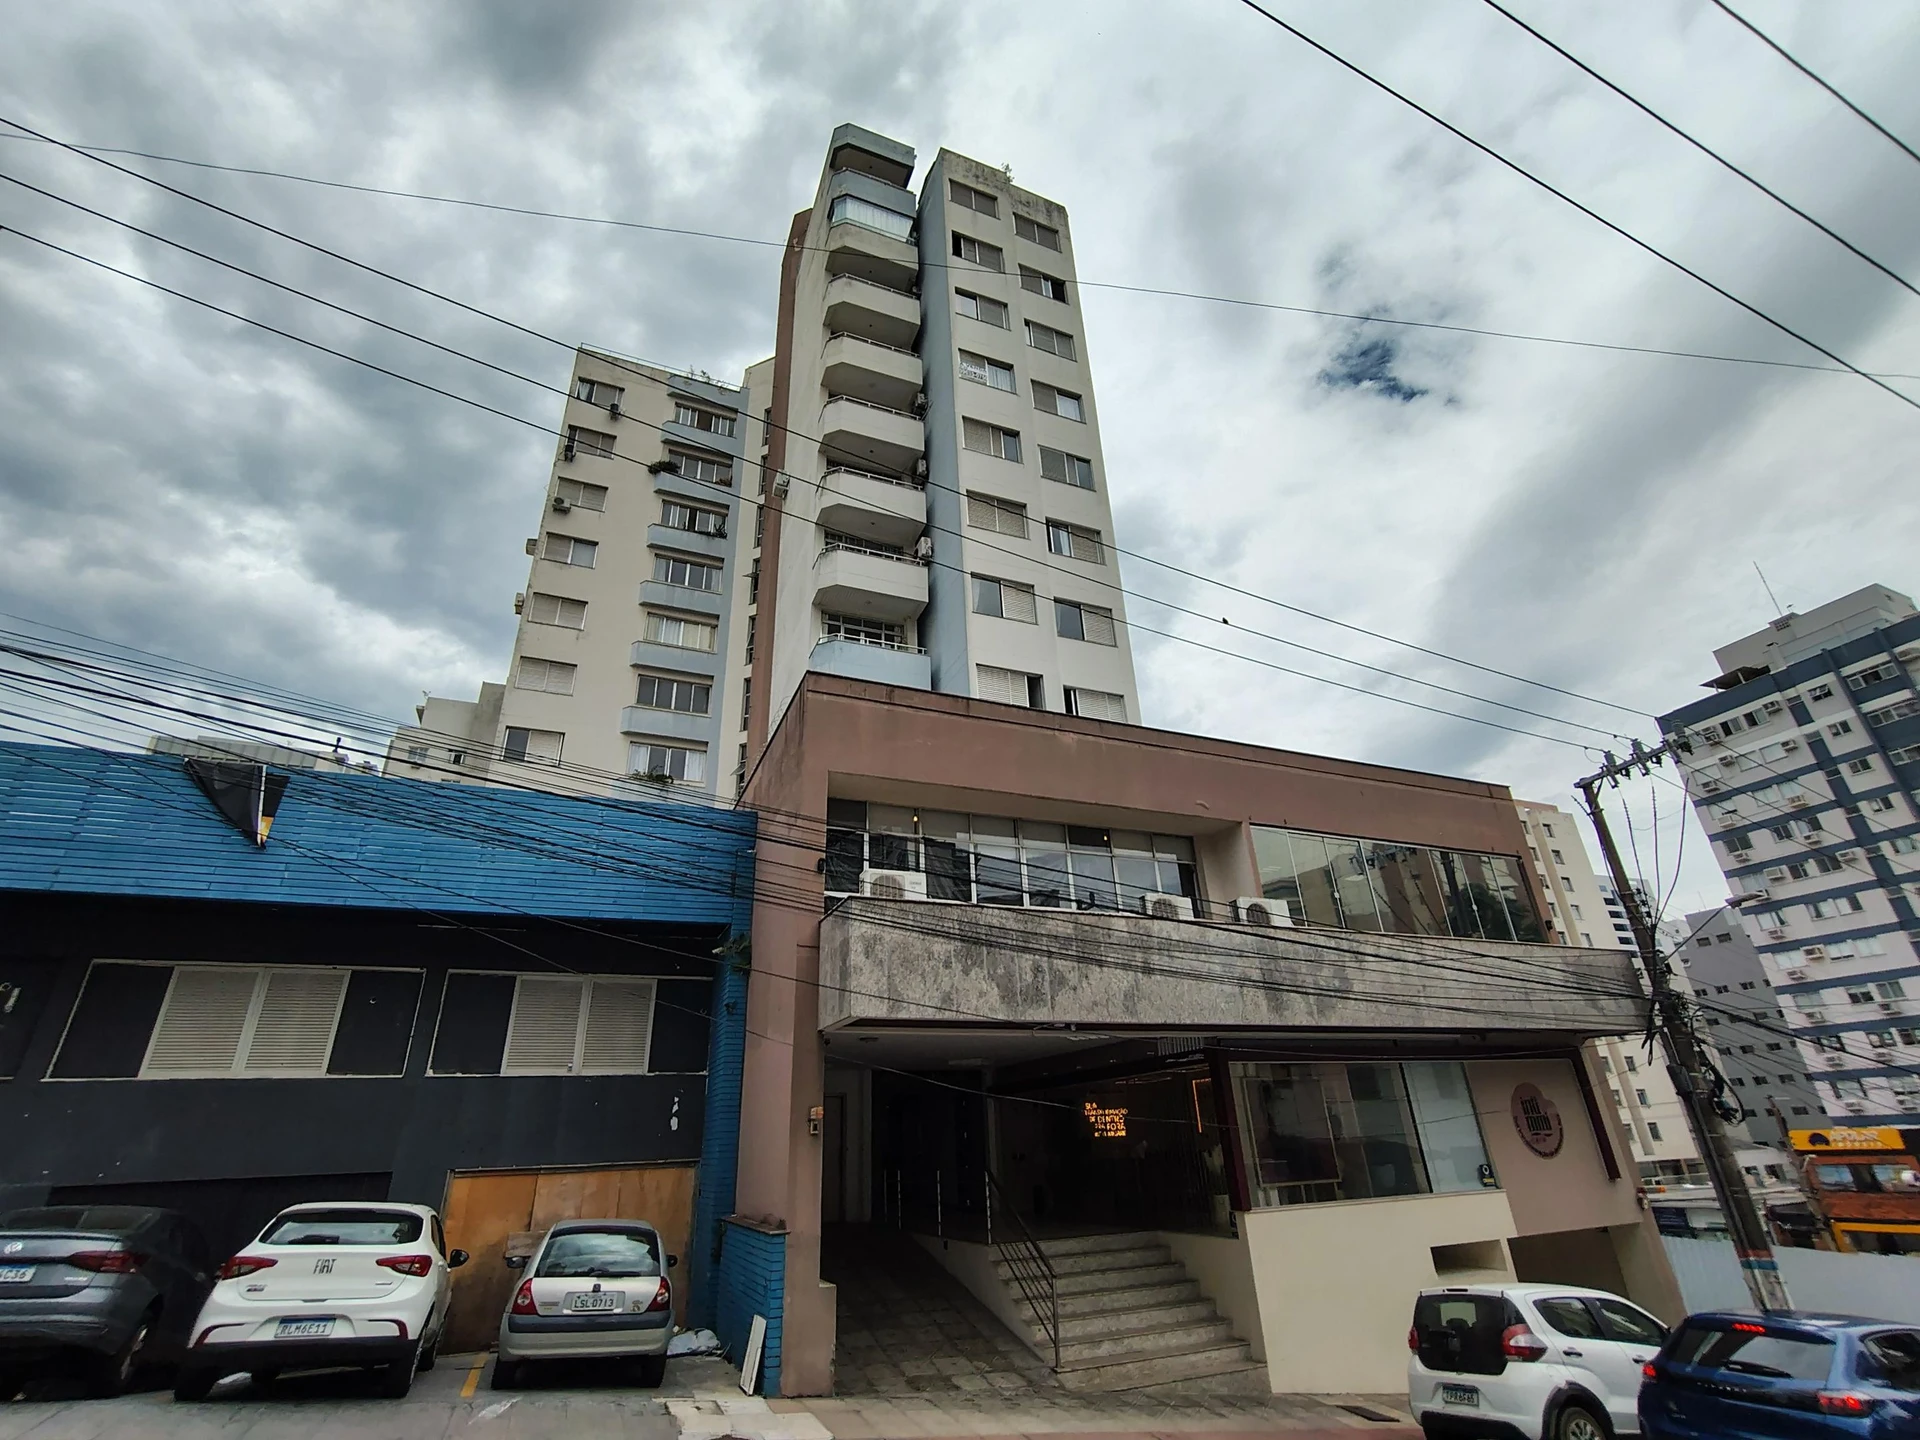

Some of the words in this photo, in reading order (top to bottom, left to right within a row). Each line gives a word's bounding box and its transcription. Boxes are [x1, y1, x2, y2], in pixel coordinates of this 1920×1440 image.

[313, 1259, 337, 1274] FIAT
[0, 1268, 27, 1280] C36
[280, 1323, 328, 1335] RLM6E11
